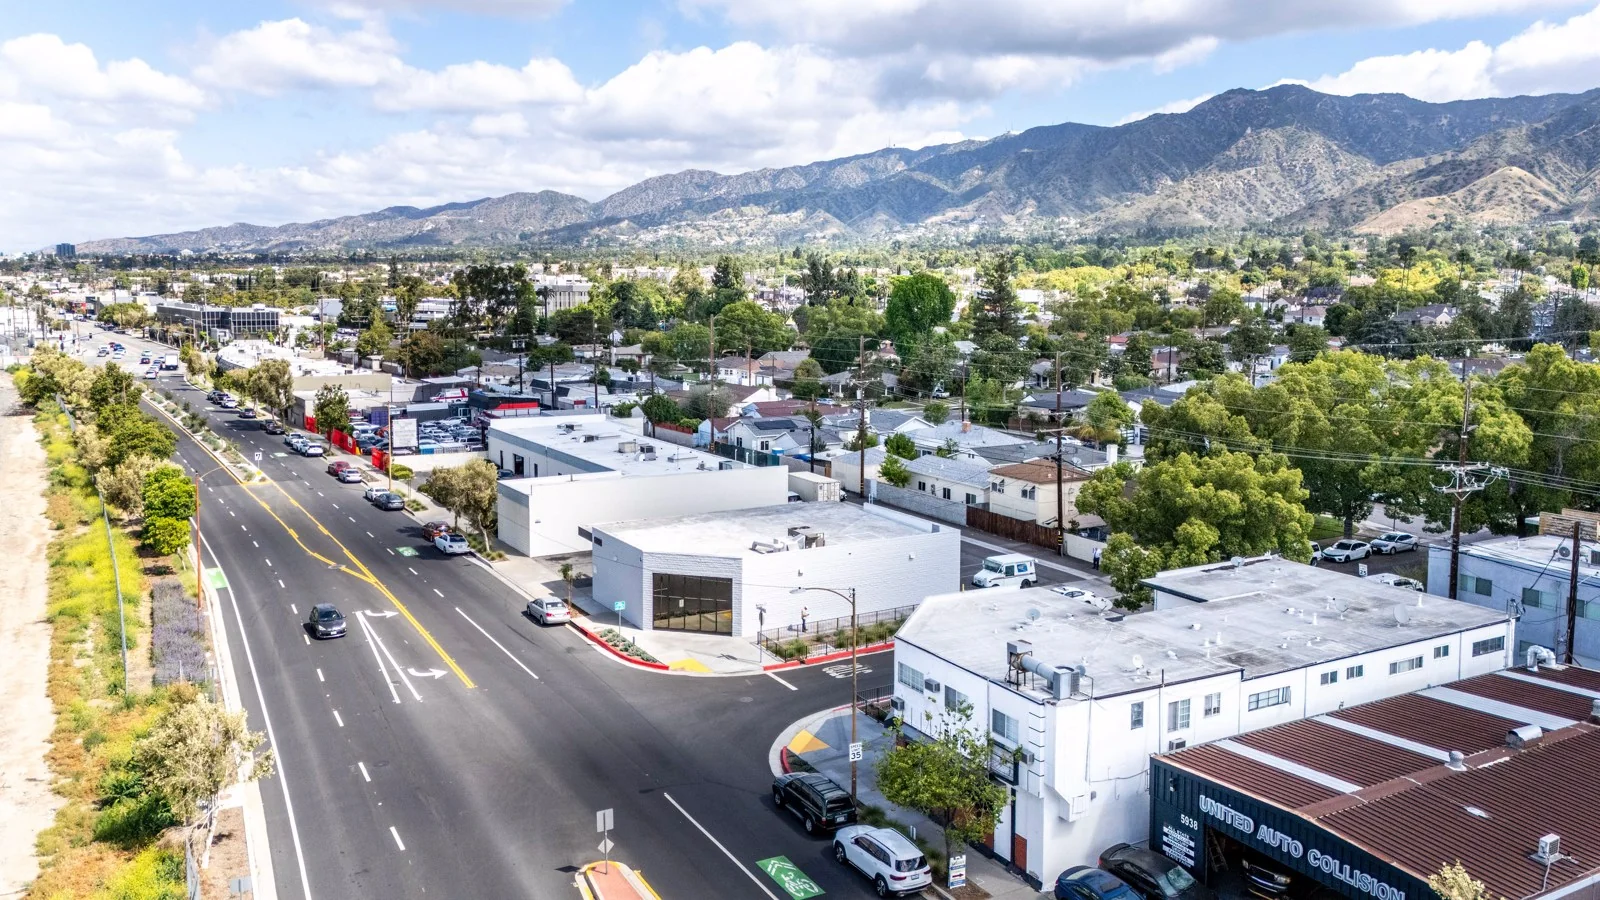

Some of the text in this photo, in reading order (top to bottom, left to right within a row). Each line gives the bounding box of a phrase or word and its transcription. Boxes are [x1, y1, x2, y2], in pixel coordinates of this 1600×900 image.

[851, 751, 861, 759] 35
[1181, 814, 1198, 830] 5938
[1199, 795, 1406, 900] UNITED AUTO COLLISION
